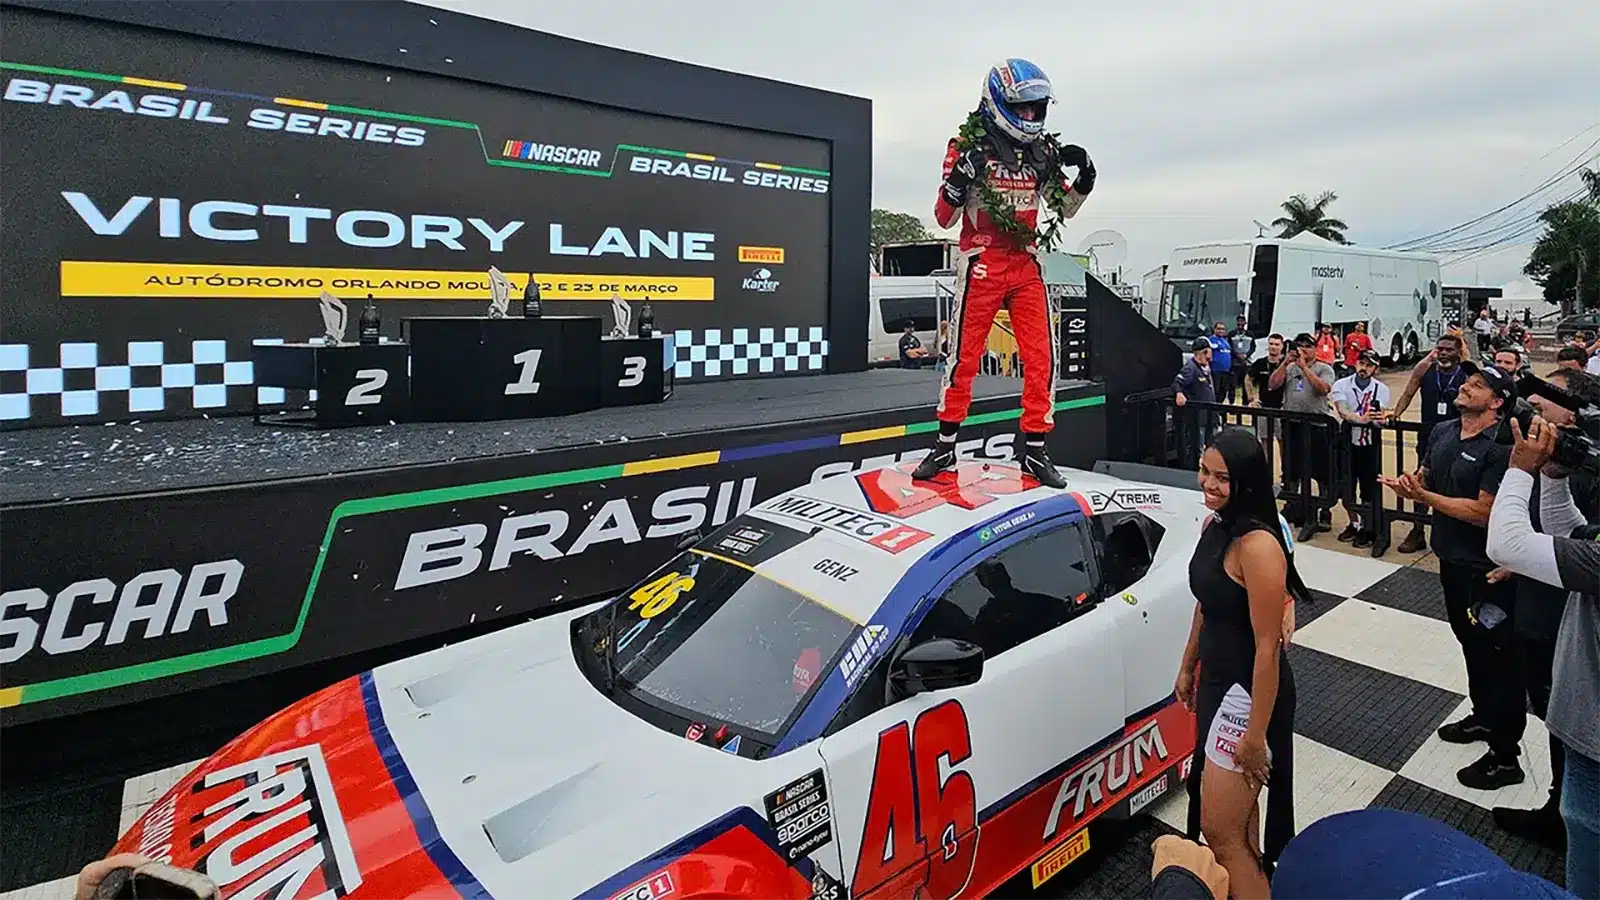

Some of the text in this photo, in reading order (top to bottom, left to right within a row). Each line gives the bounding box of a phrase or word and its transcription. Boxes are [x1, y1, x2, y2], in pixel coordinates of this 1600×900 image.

[4, 78, 427, 147] BRASIL SERIES
[527, 142, 601, 168] NASCAR
[629, 156, 829, 194] BRASIL SERIES
[60, 191, 715, 261] VICTORY LANE
[1183, 257, 1228, 266] IMPRENSA
[1311, 265, 1345, 278] mastertv
[145, 273, 323, 288] AUTÓDROMO
[332, 279, 442, 291] ORLANDO
[448, 281, 523, 292] MOUA,
[558, 283, 568, 291] E
[573, 283, 594, 292] 23
[599, 284, 620, 292] DE
[624, 284, 679, 293] MARÇO
[742, 278, 779, 289] Karter
[345, 368, 389, 406] 2
[504, 349, 543, 396] 1
[618, 356, 647, 387] 3
[1087, 489, 1161, 512] EXTREME
[767, 495, 919, 549] MILITEC 1
[812, 558, 859, 582] GENZ
[628, 571, 696, 619] 46
[785, 778, 814, 800] NASCAR
[1043, 718, 1168, 840] FRUM
[774, 790, 820, 823] BRASIL SERIES
[850, 698, 980, 900] 46
[1037, 833, 1085, 881] PIRELLI
